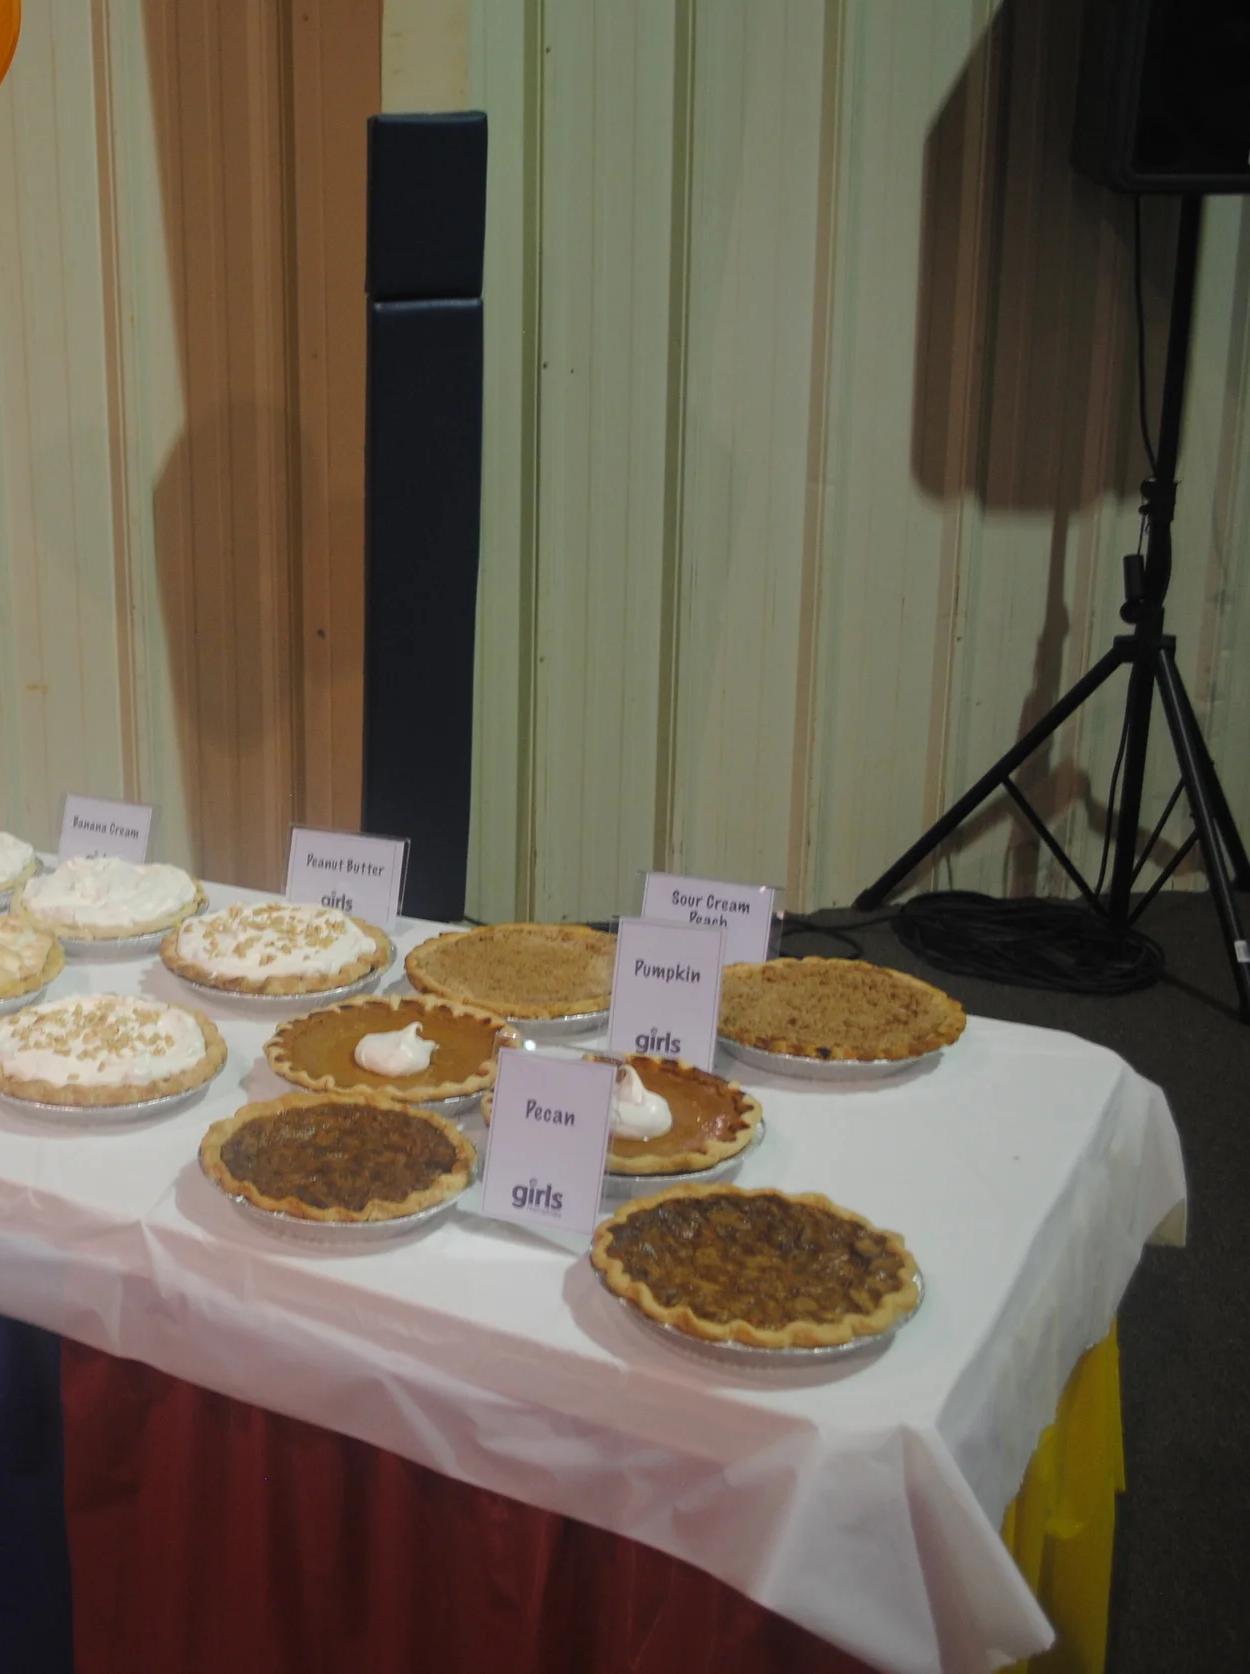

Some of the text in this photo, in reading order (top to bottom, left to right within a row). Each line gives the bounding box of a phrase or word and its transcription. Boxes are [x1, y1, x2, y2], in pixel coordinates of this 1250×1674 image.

[72, 815, 139, 840] Banana Cream
[306, 853, 385, 877] Peanut Butter
[320, 889, 353, 913] girls
[671, 889, 750, 914] Sour Cream
[634, 959, 701, 983] Pumpkin
[635, 1027, 681, 1053] girls
[525, 1098, 575, 1126] Pecan
[511, 1177, 563, 1210] girls
